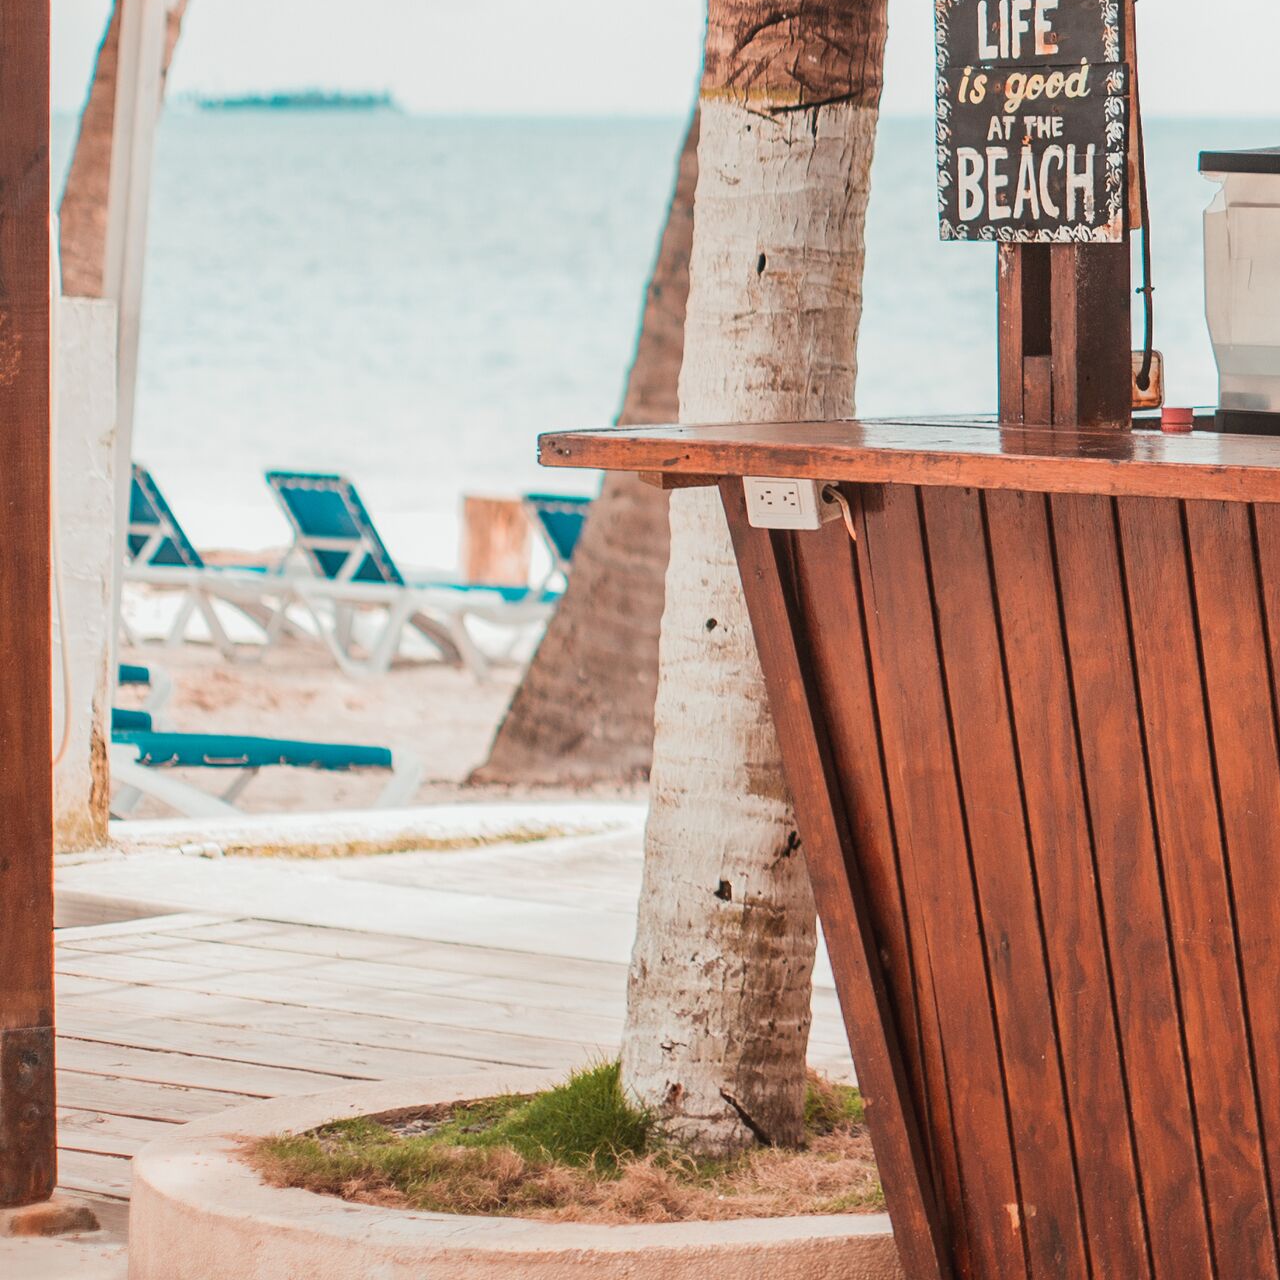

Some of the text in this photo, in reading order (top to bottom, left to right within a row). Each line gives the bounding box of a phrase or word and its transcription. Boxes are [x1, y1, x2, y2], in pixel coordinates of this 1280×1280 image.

[958, 56, 1091, 113] is good
[987, 115, 1064, 141] AT THE
[956, 143, 1096, 224] BEACH
